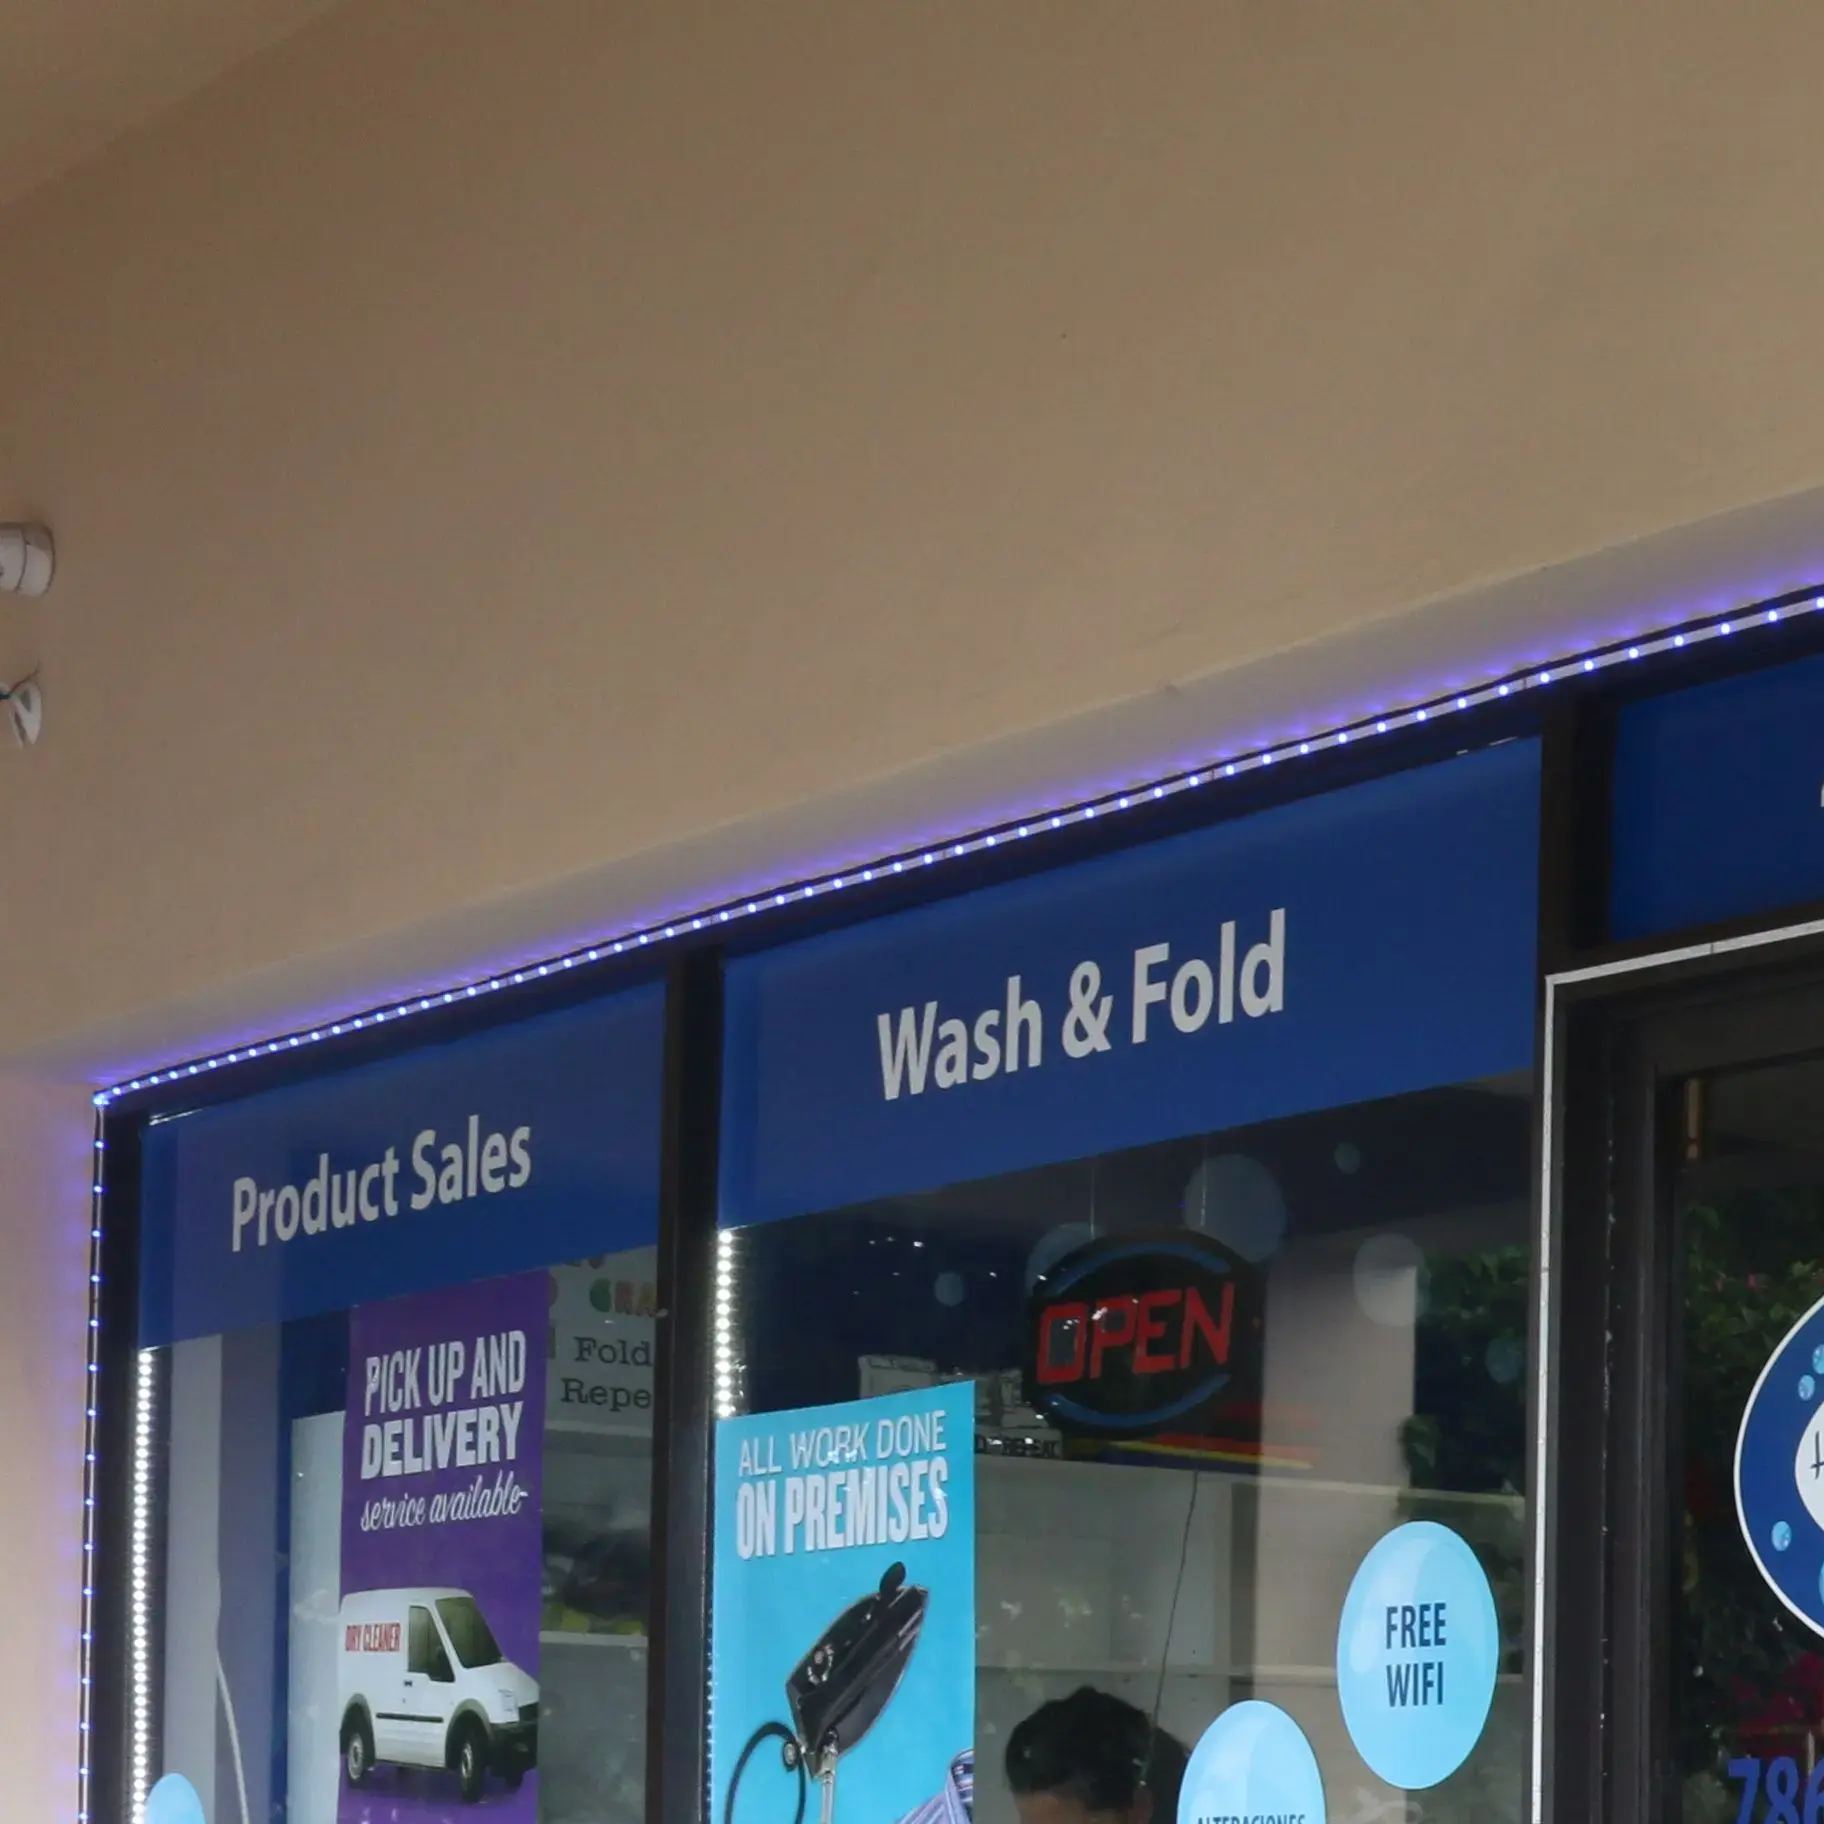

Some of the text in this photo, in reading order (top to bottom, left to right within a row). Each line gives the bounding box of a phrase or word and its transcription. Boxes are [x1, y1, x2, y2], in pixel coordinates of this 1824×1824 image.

[877, 908, 1286, 1101] Wash & Fold
[232, 1114, 532, 1252] Product Sales
[364, 1329, 527, 1417] PICK UP AND
[1035, 1281, 1235, 1385] OPEN
[361, 1400, 524, 1480] DELIVERY
[738, 1434, 783, 1478] ALL
[790, 1421, 870, 1470] WORK
[876, 1409, 947, 1460] DONE
[361, 1469, 527, 1533] service available
[737, 1455, 949, 1560] ON PREMISES
[345, 1621, 402, 1652] DRY CLEANER
[1385, 1602, 1447, 1650] FREE
[1385, 1661, 1445, 1708] WIFI
